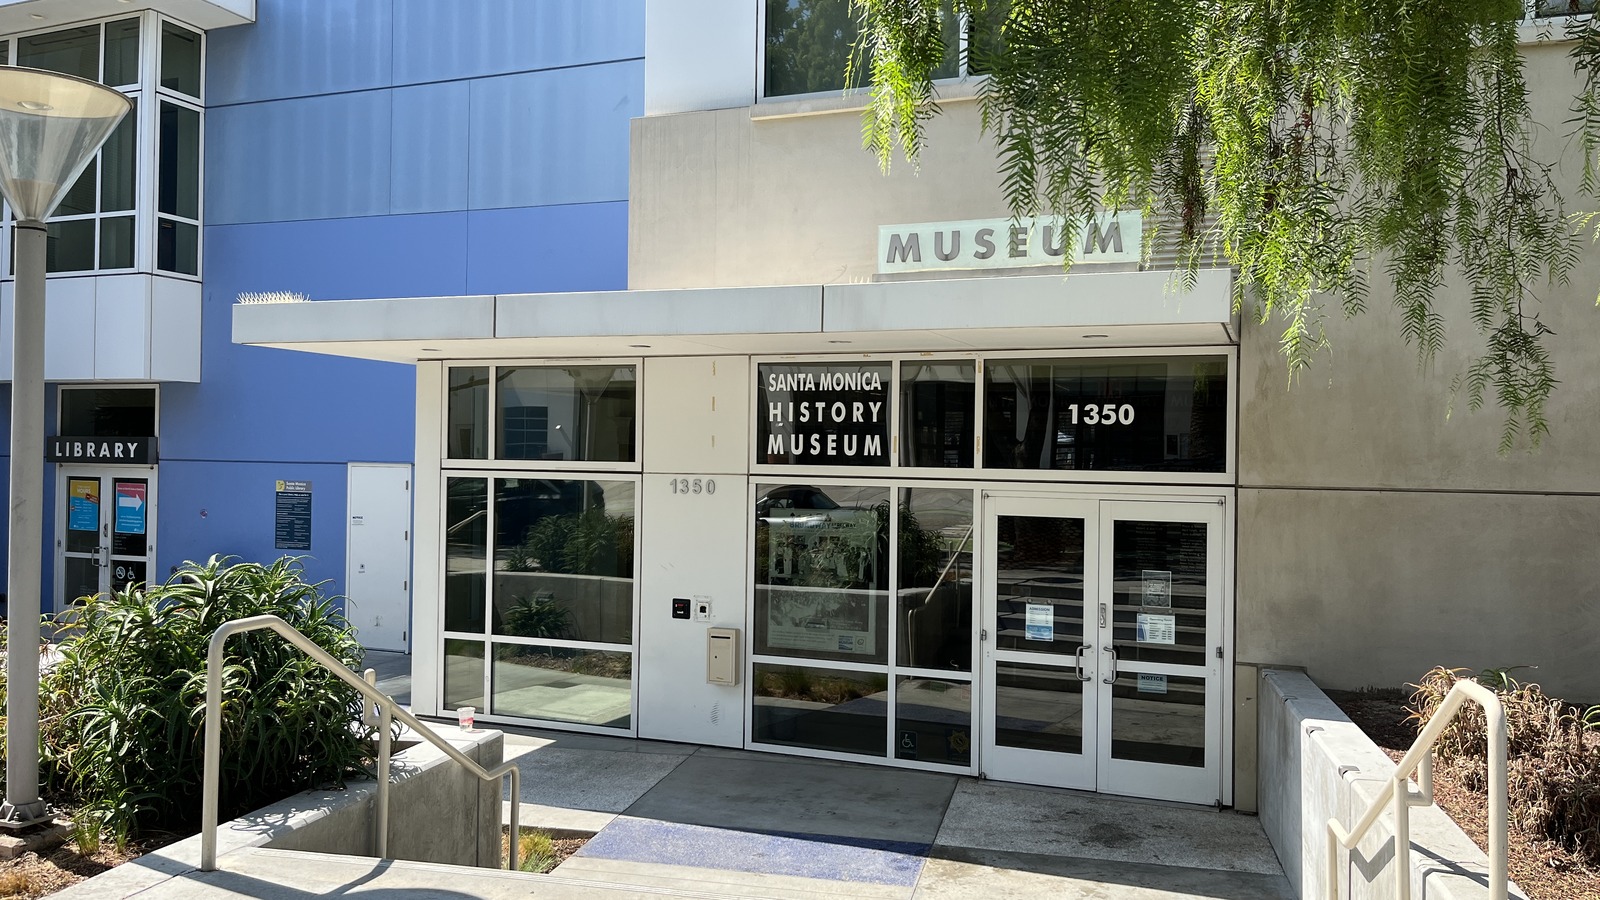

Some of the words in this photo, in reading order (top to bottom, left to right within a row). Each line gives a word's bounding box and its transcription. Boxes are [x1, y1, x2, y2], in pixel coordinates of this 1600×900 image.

[886, 221, 1124, 264] MUSEUM
[768, 373, 816, 392] SANTA
[819, 372, 882, 391] MONICA
[768, 401, 882, 423] HISTORY
[1068, 403, 1135, 425] 1350
[55, 441, 138, 458] LIBRARY
[767, 433, 882, 456] MUSEUM
[669, 478, 716, 495] 1350
